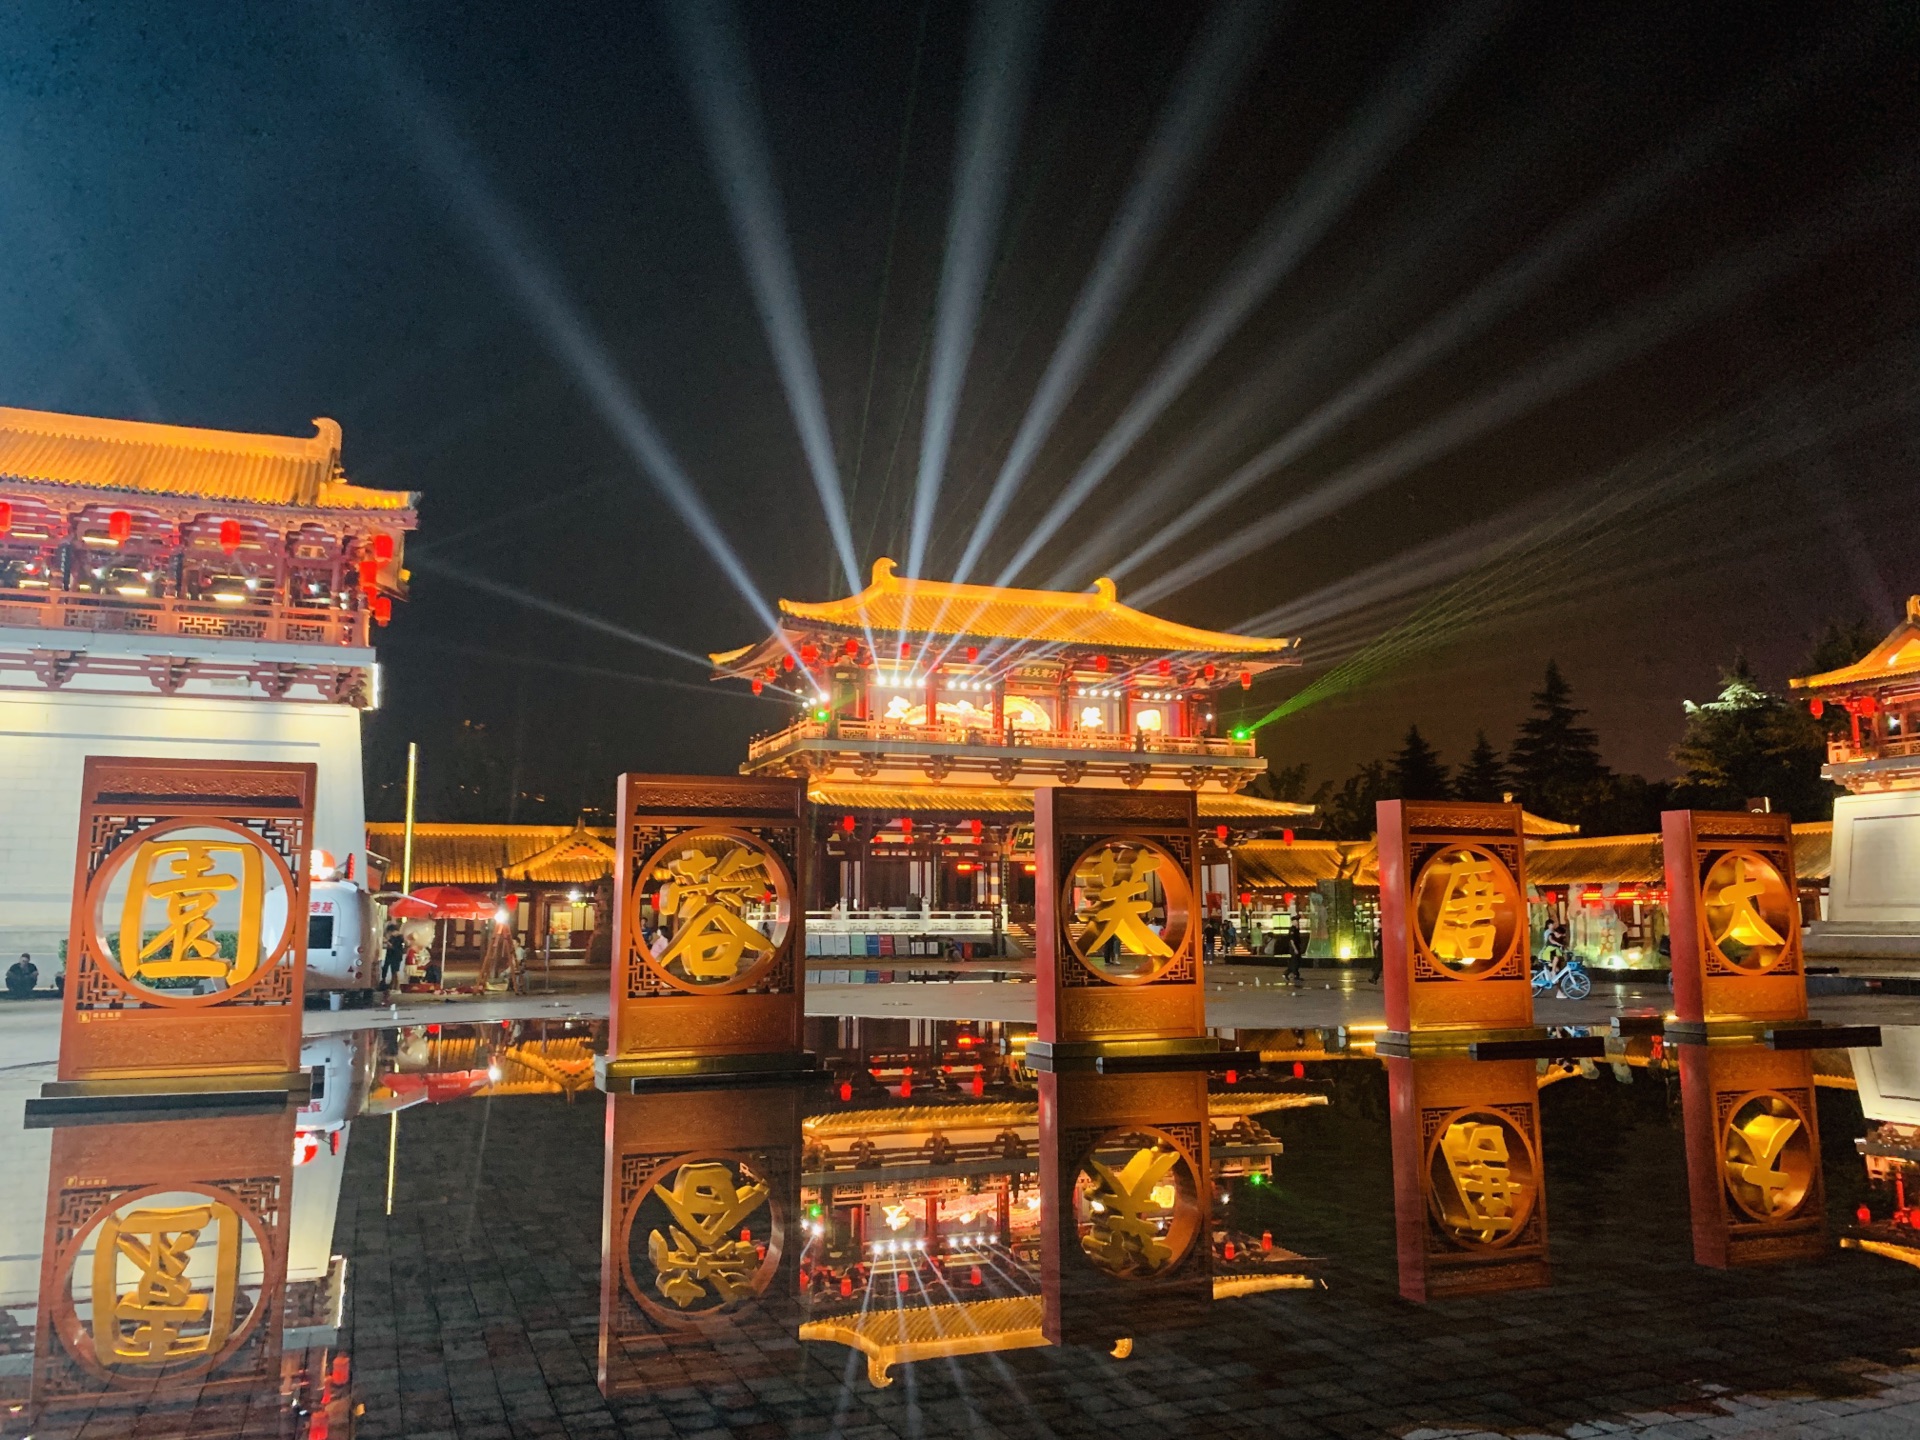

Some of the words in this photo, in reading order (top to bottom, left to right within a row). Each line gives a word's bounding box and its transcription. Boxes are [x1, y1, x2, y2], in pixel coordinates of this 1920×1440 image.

[120, 840, 263, 986] 園
[660, 847, 776, 978] 蓉
[1076, 848, 1174, 958] 芙
[1430, 851, 1505, 959] 唐
[1715, 857, 1785, 946] 大
